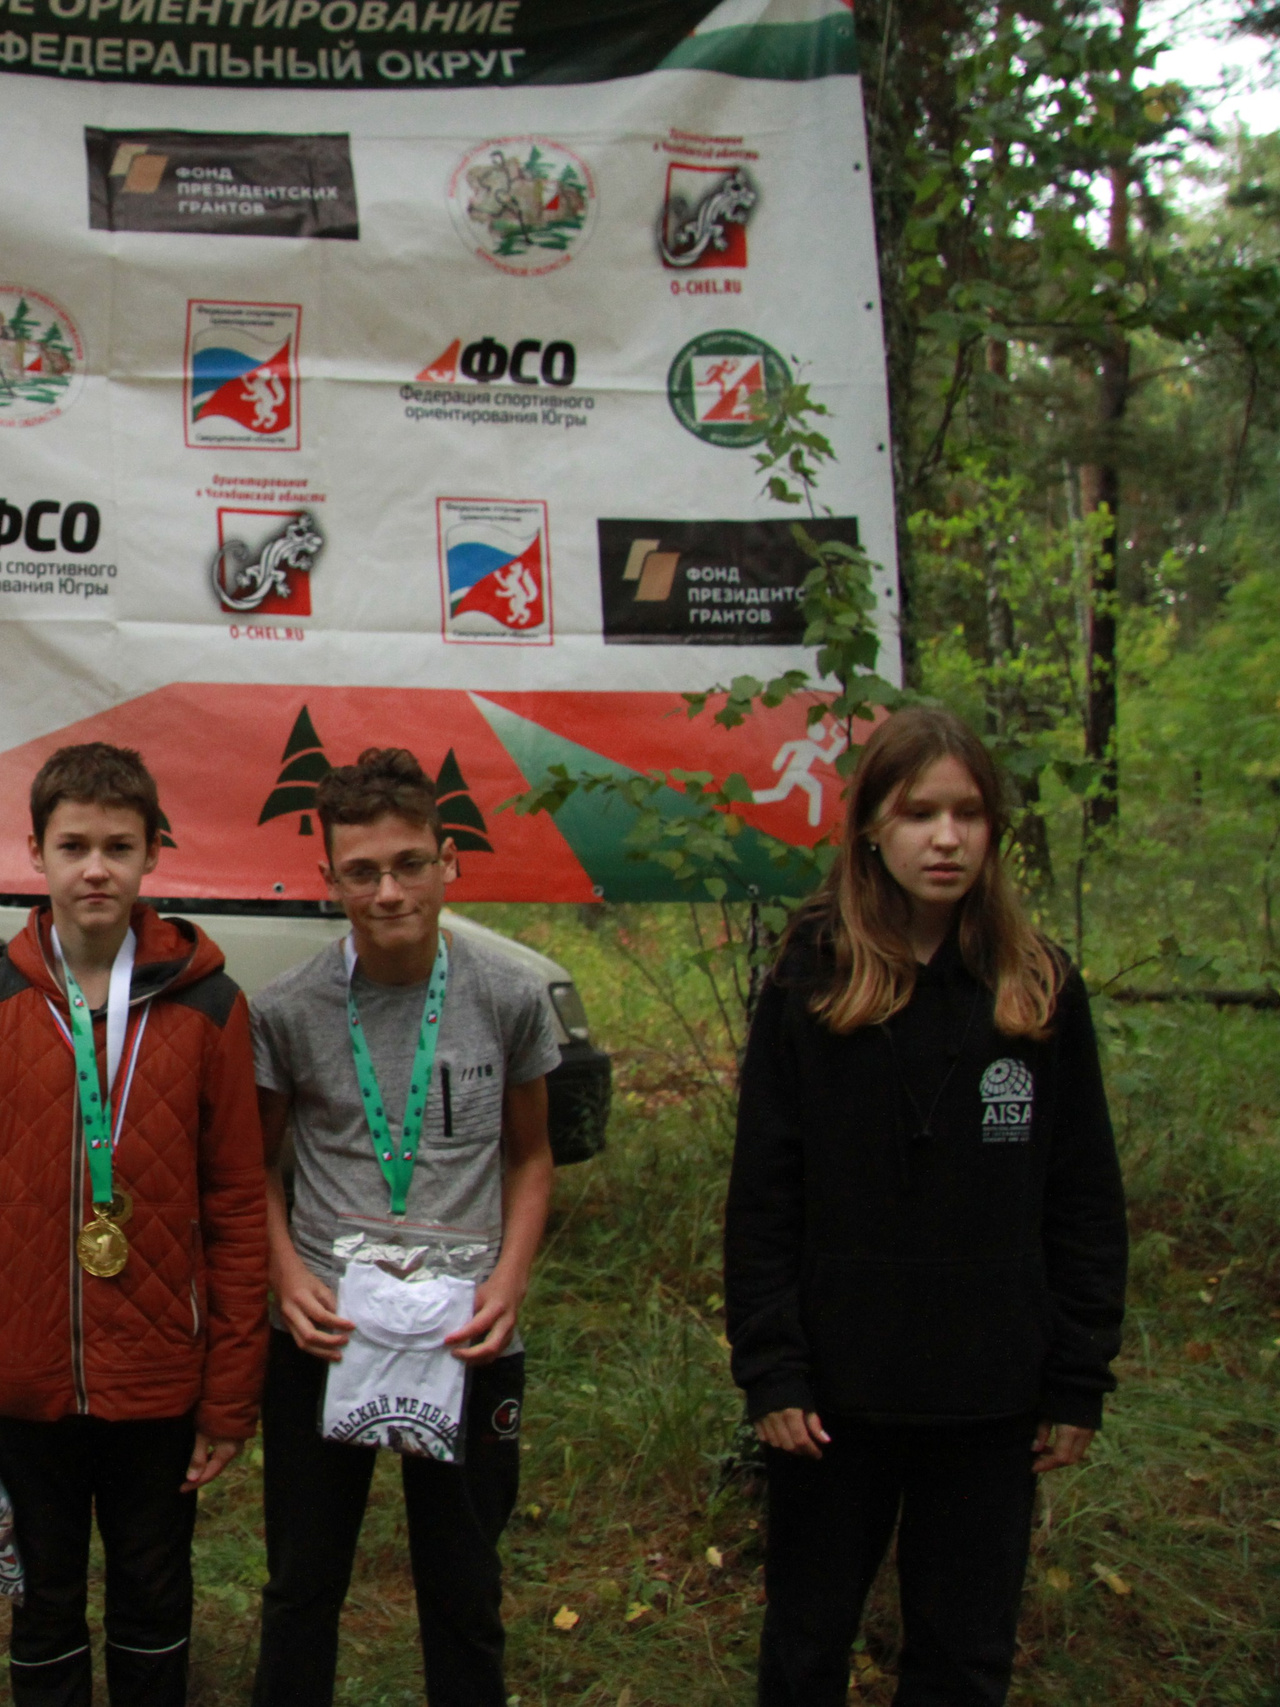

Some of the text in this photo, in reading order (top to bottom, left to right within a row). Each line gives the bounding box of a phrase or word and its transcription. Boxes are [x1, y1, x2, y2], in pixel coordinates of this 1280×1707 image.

[50, 0, 519, 35] ОРИЕНТИРОВАНИЕ
[376, 48, 526, 81] ОКРУГ
[175, 166, 234, 182] ФОНД
[177, 182, 340, 201] ПРЕЗИДЕНТСКИХ
[178, 201, 266, 216] ГРАНТОВ
[460, 336, 578, 387] ФСО
[399, 384, 596, 410] Федерация спортивного
[404, 405, 588, 430] ориентирования Югры
[6, 560, 118, 578] спортивного
[686, 566, 741, 584] ФОНД
[58, 577, 110, 599] Югры
[687, 586, 830, 605] ПРЕЗИДЕНТС
[689, 608, 772, 624] ГРАНТОВ
[981, 1103, 1032, 1125] AISA
[327, 1394, 391, 1441] ЛЬСКИЙ
